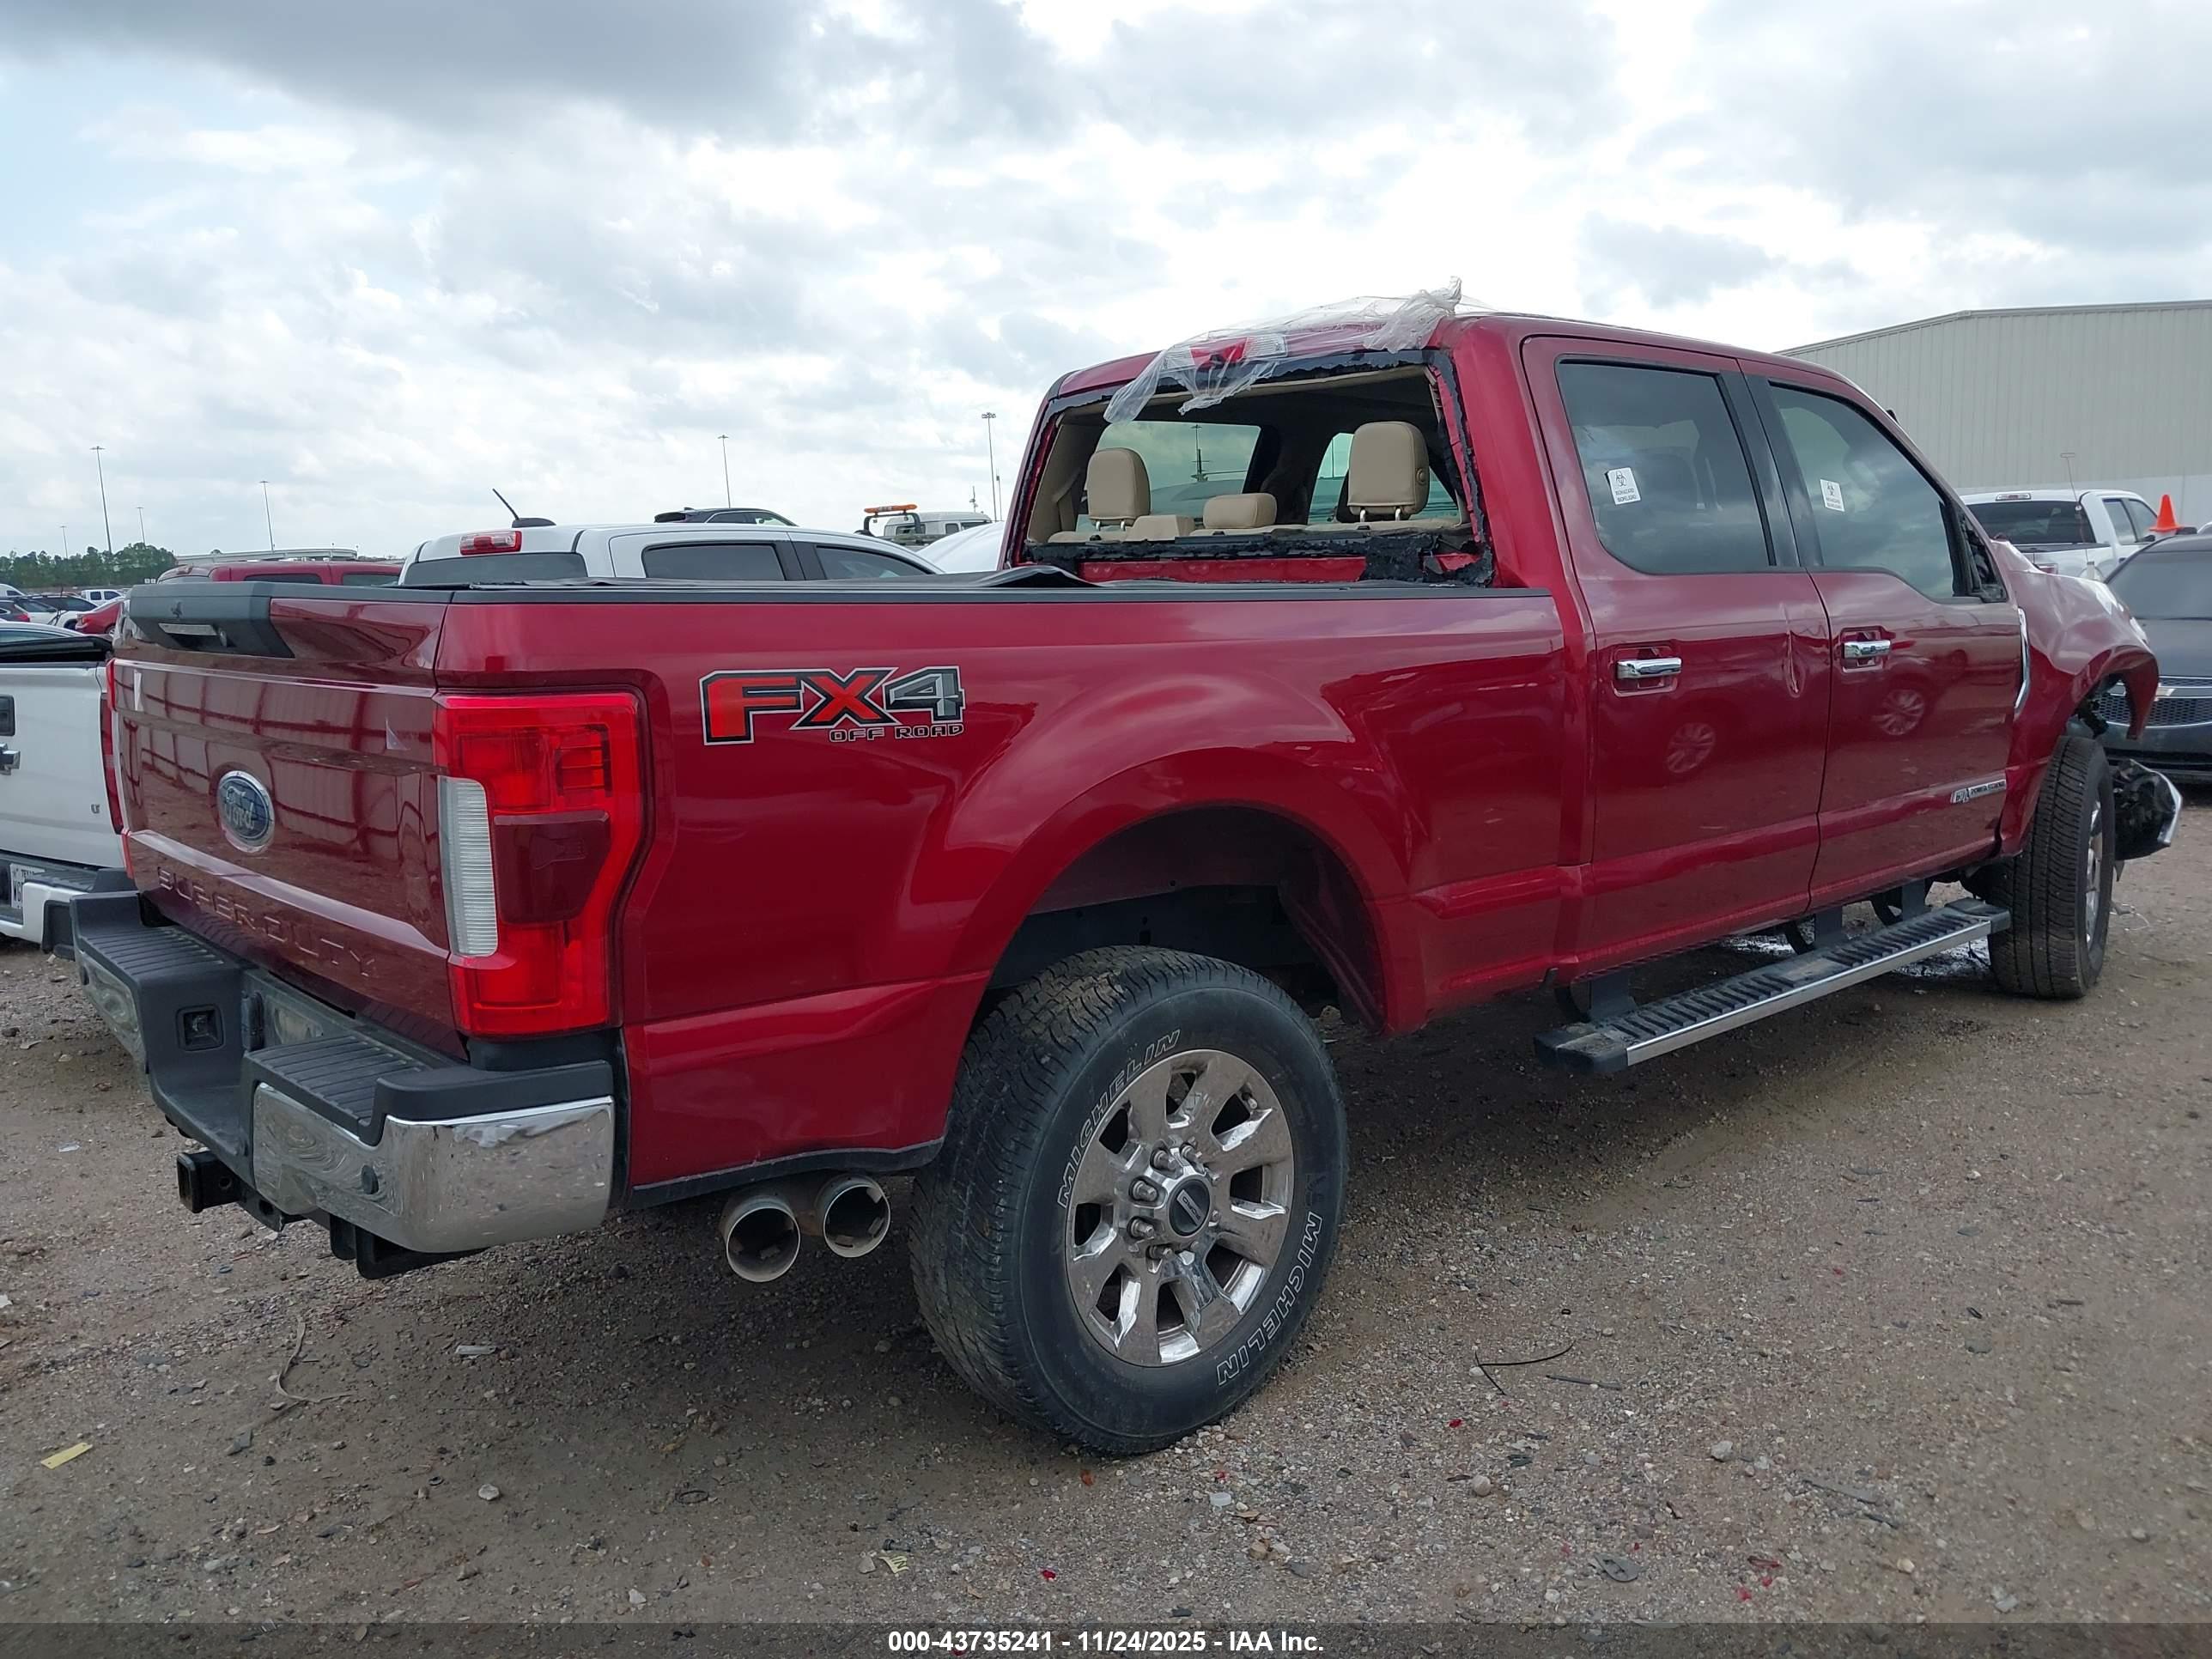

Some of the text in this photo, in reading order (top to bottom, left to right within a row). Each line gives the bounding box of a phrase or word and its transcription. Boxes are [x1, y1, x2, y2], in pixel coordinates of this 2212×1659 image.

[699, 665, 966, 745] FX4
[829, 723, 964, 743] OFF ROAD
[157, 866, 376, 977] SUPER DUTY
[1057, 1029, 1181, 1208] MICHELIN
[1216, 1211, 1322, 1386] MICHELIN
